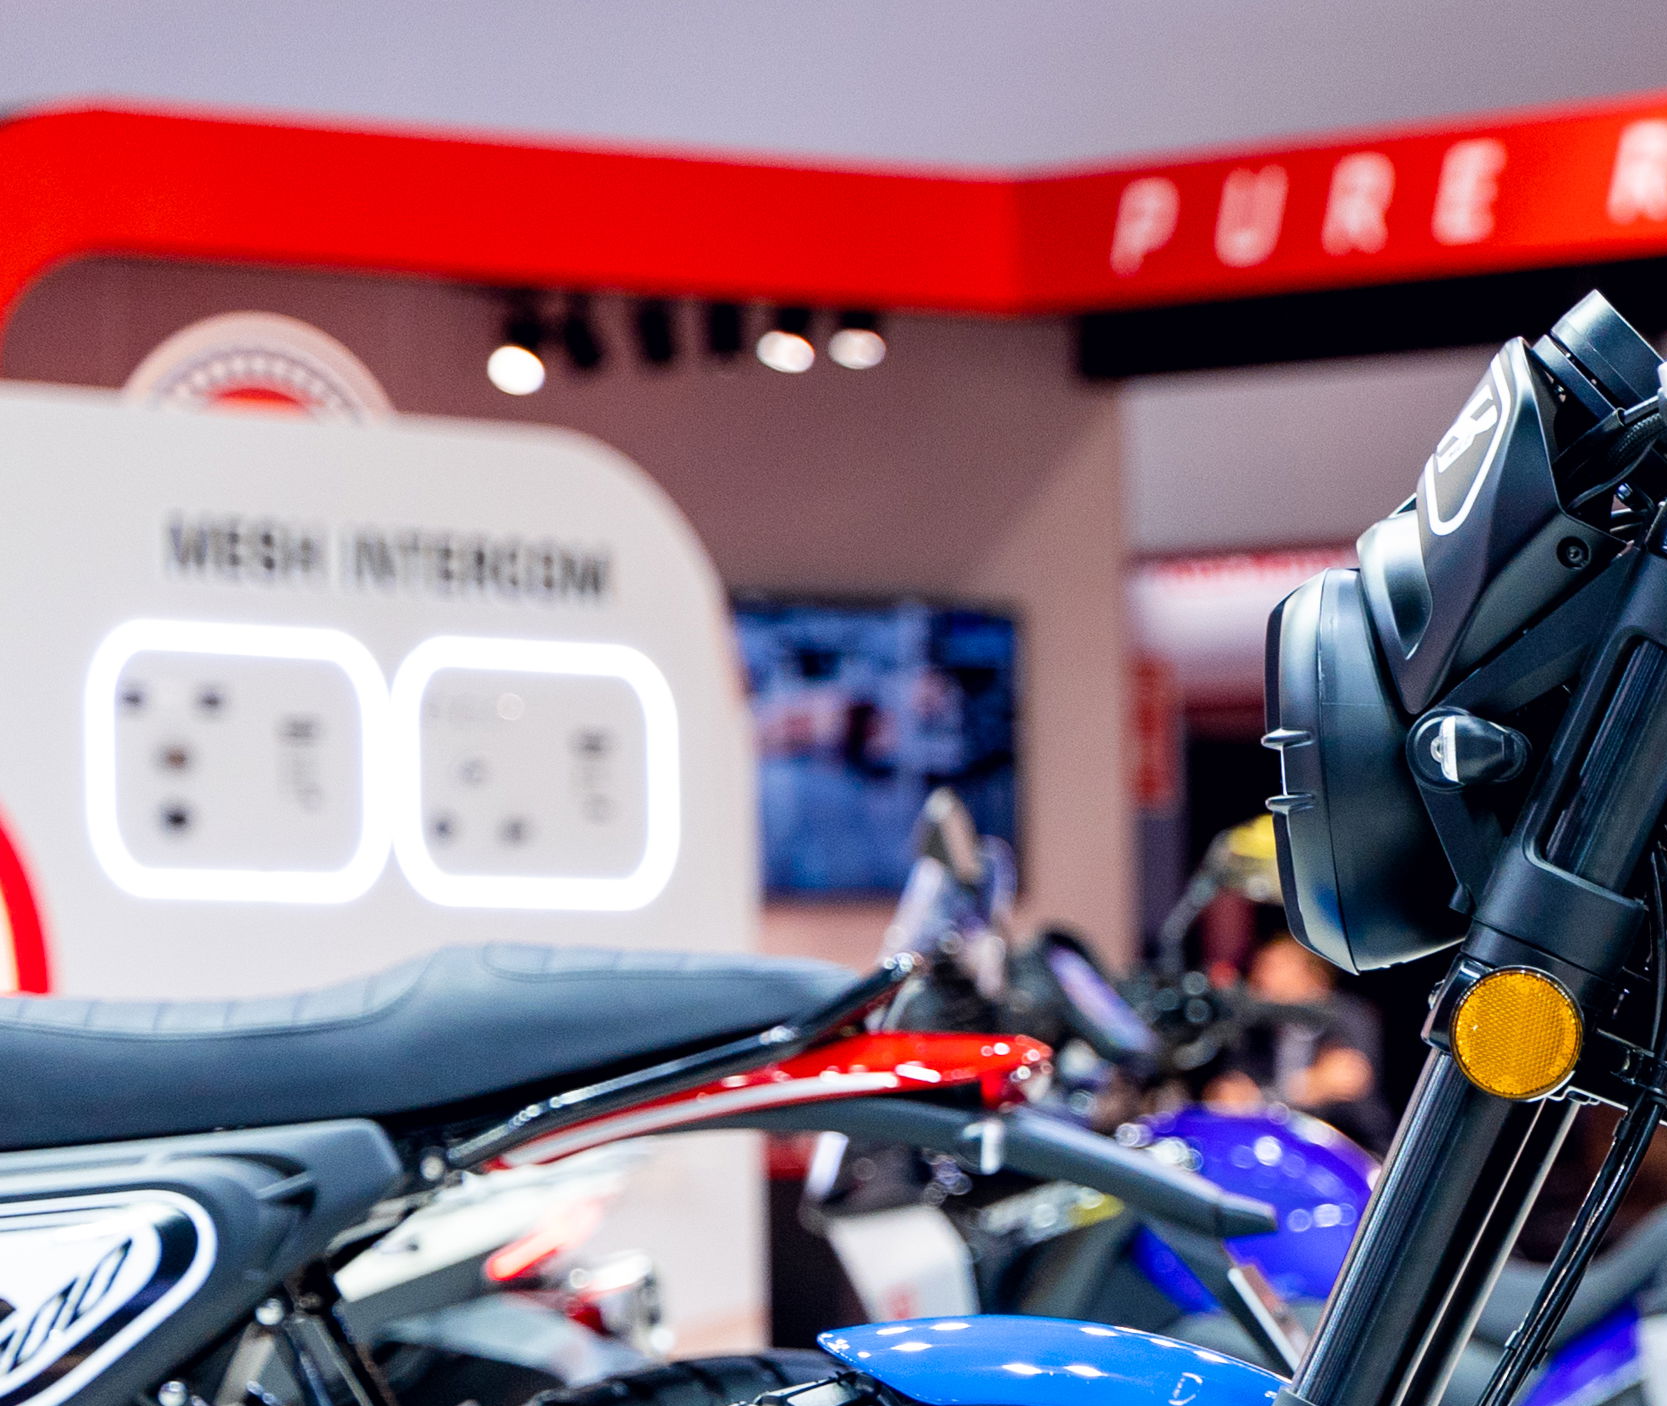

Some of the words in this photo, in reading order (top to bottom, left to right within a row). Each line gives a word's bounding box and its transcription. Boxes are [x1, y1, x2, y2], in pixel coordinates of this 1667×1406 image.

[1109, 139, 1508, 276] PURE
[164, 508, 324, 590] MESH
[350, 525, 613, 605] INTERCOM
